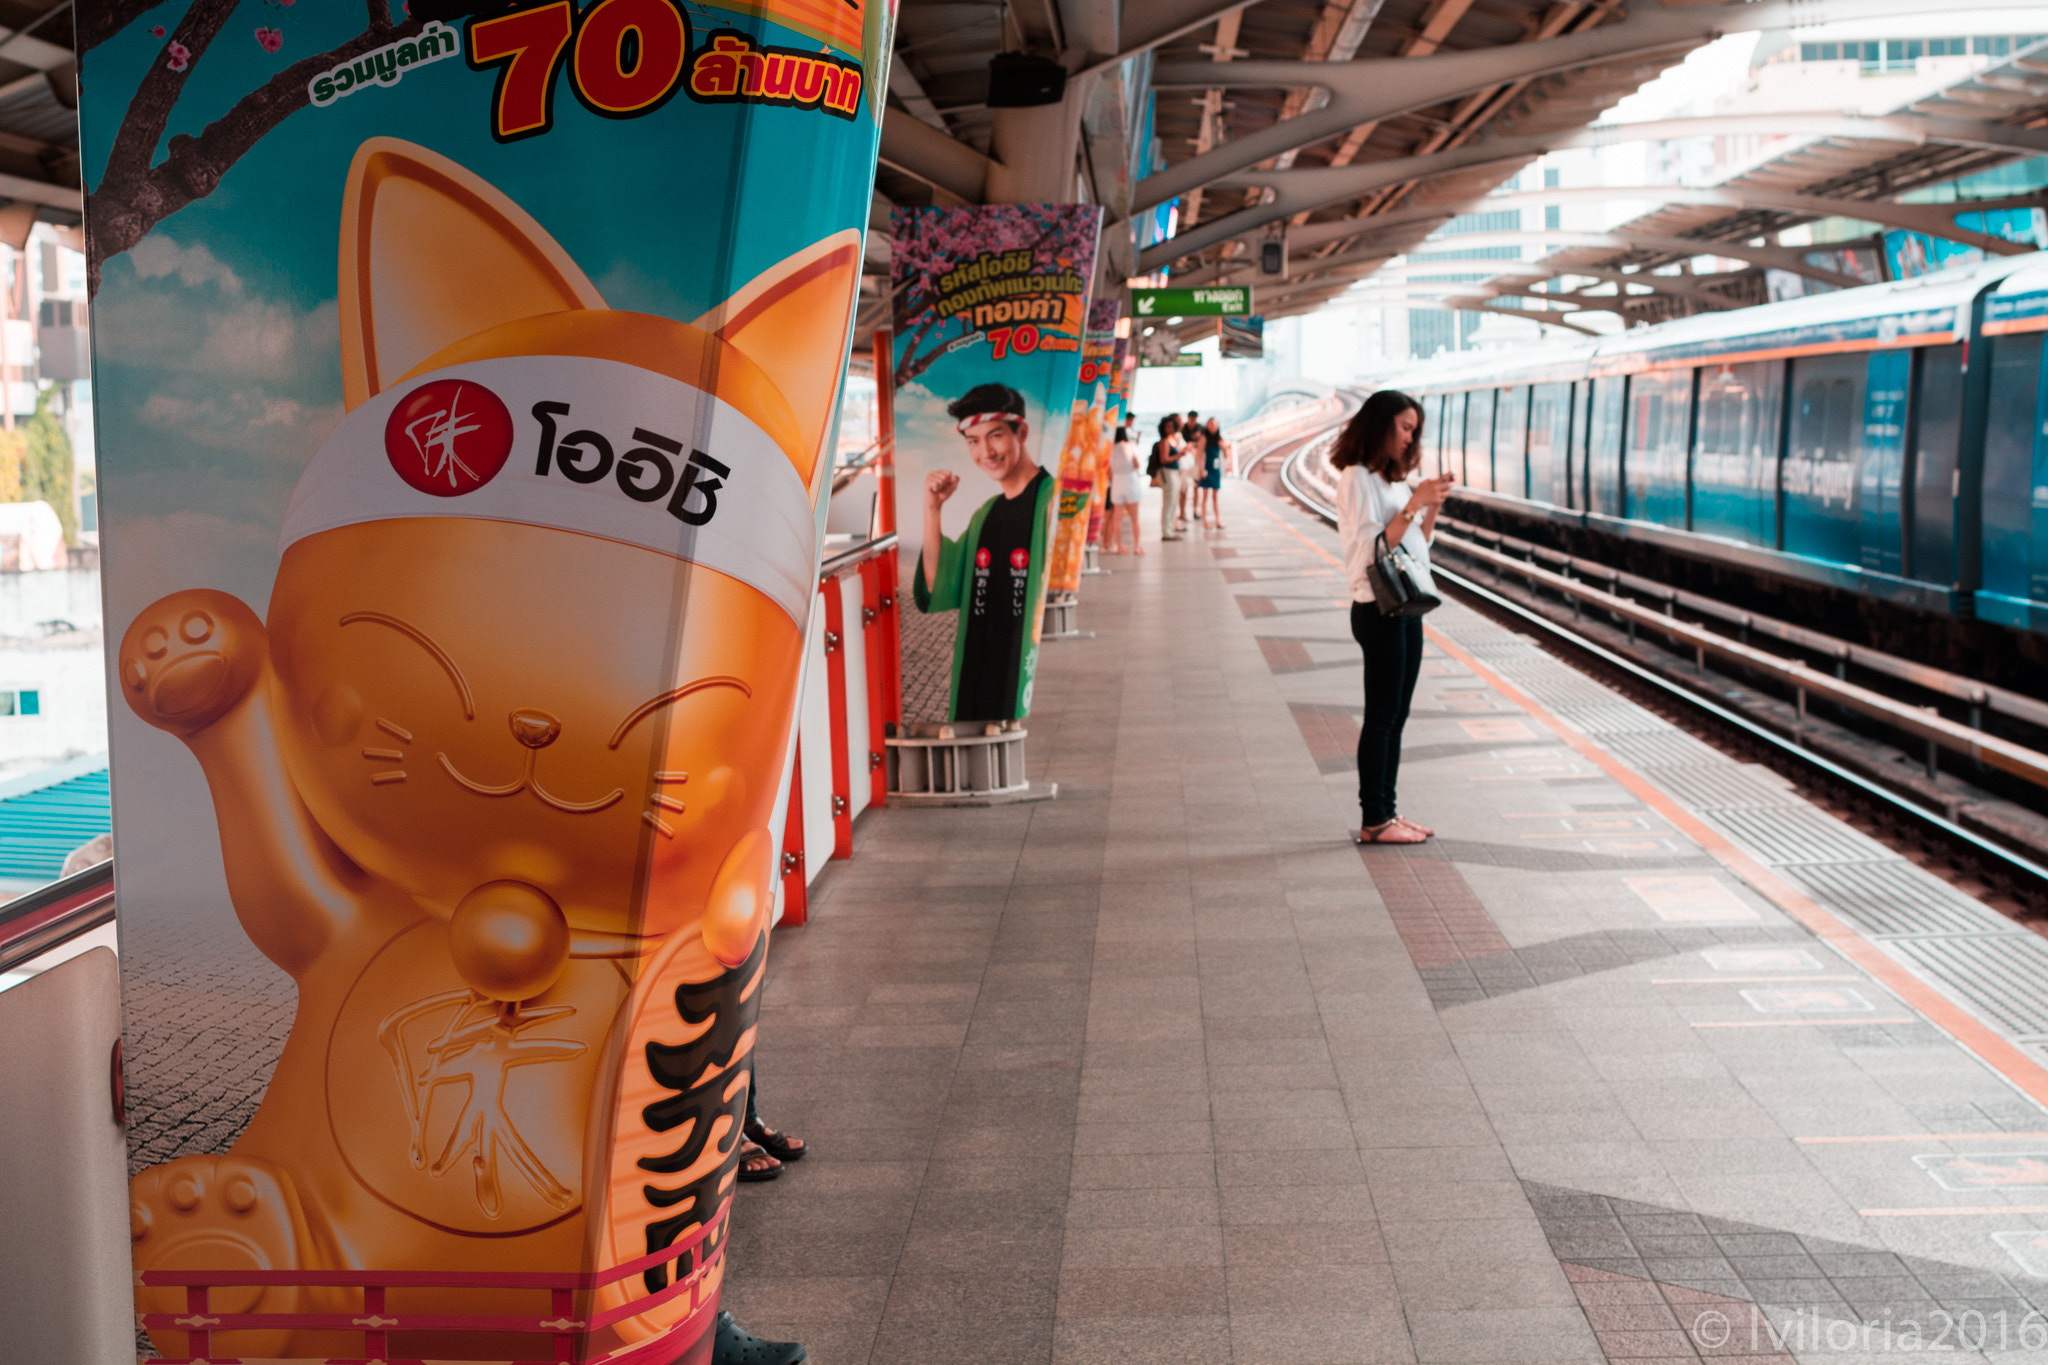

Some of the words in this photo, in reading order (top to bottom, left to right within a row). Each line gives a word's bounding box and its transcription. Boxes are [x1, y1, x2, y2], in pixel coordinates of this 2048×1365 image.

[313, 28, 456, 101] รวมมูลค่า
[472, 0, 685, 137] 70
[690, 36, 862, 115] ล้านบาท
[937, 269, 1083, 317] กองทัพแมวเนโกะ
[940, 250, 1032, 292] รหัสโออิชิ
[975, 292, 1063, 327] ทองคำ
[987, 324, 1040, 360] 70
[531, 400, 731, 527] โออิชิ
